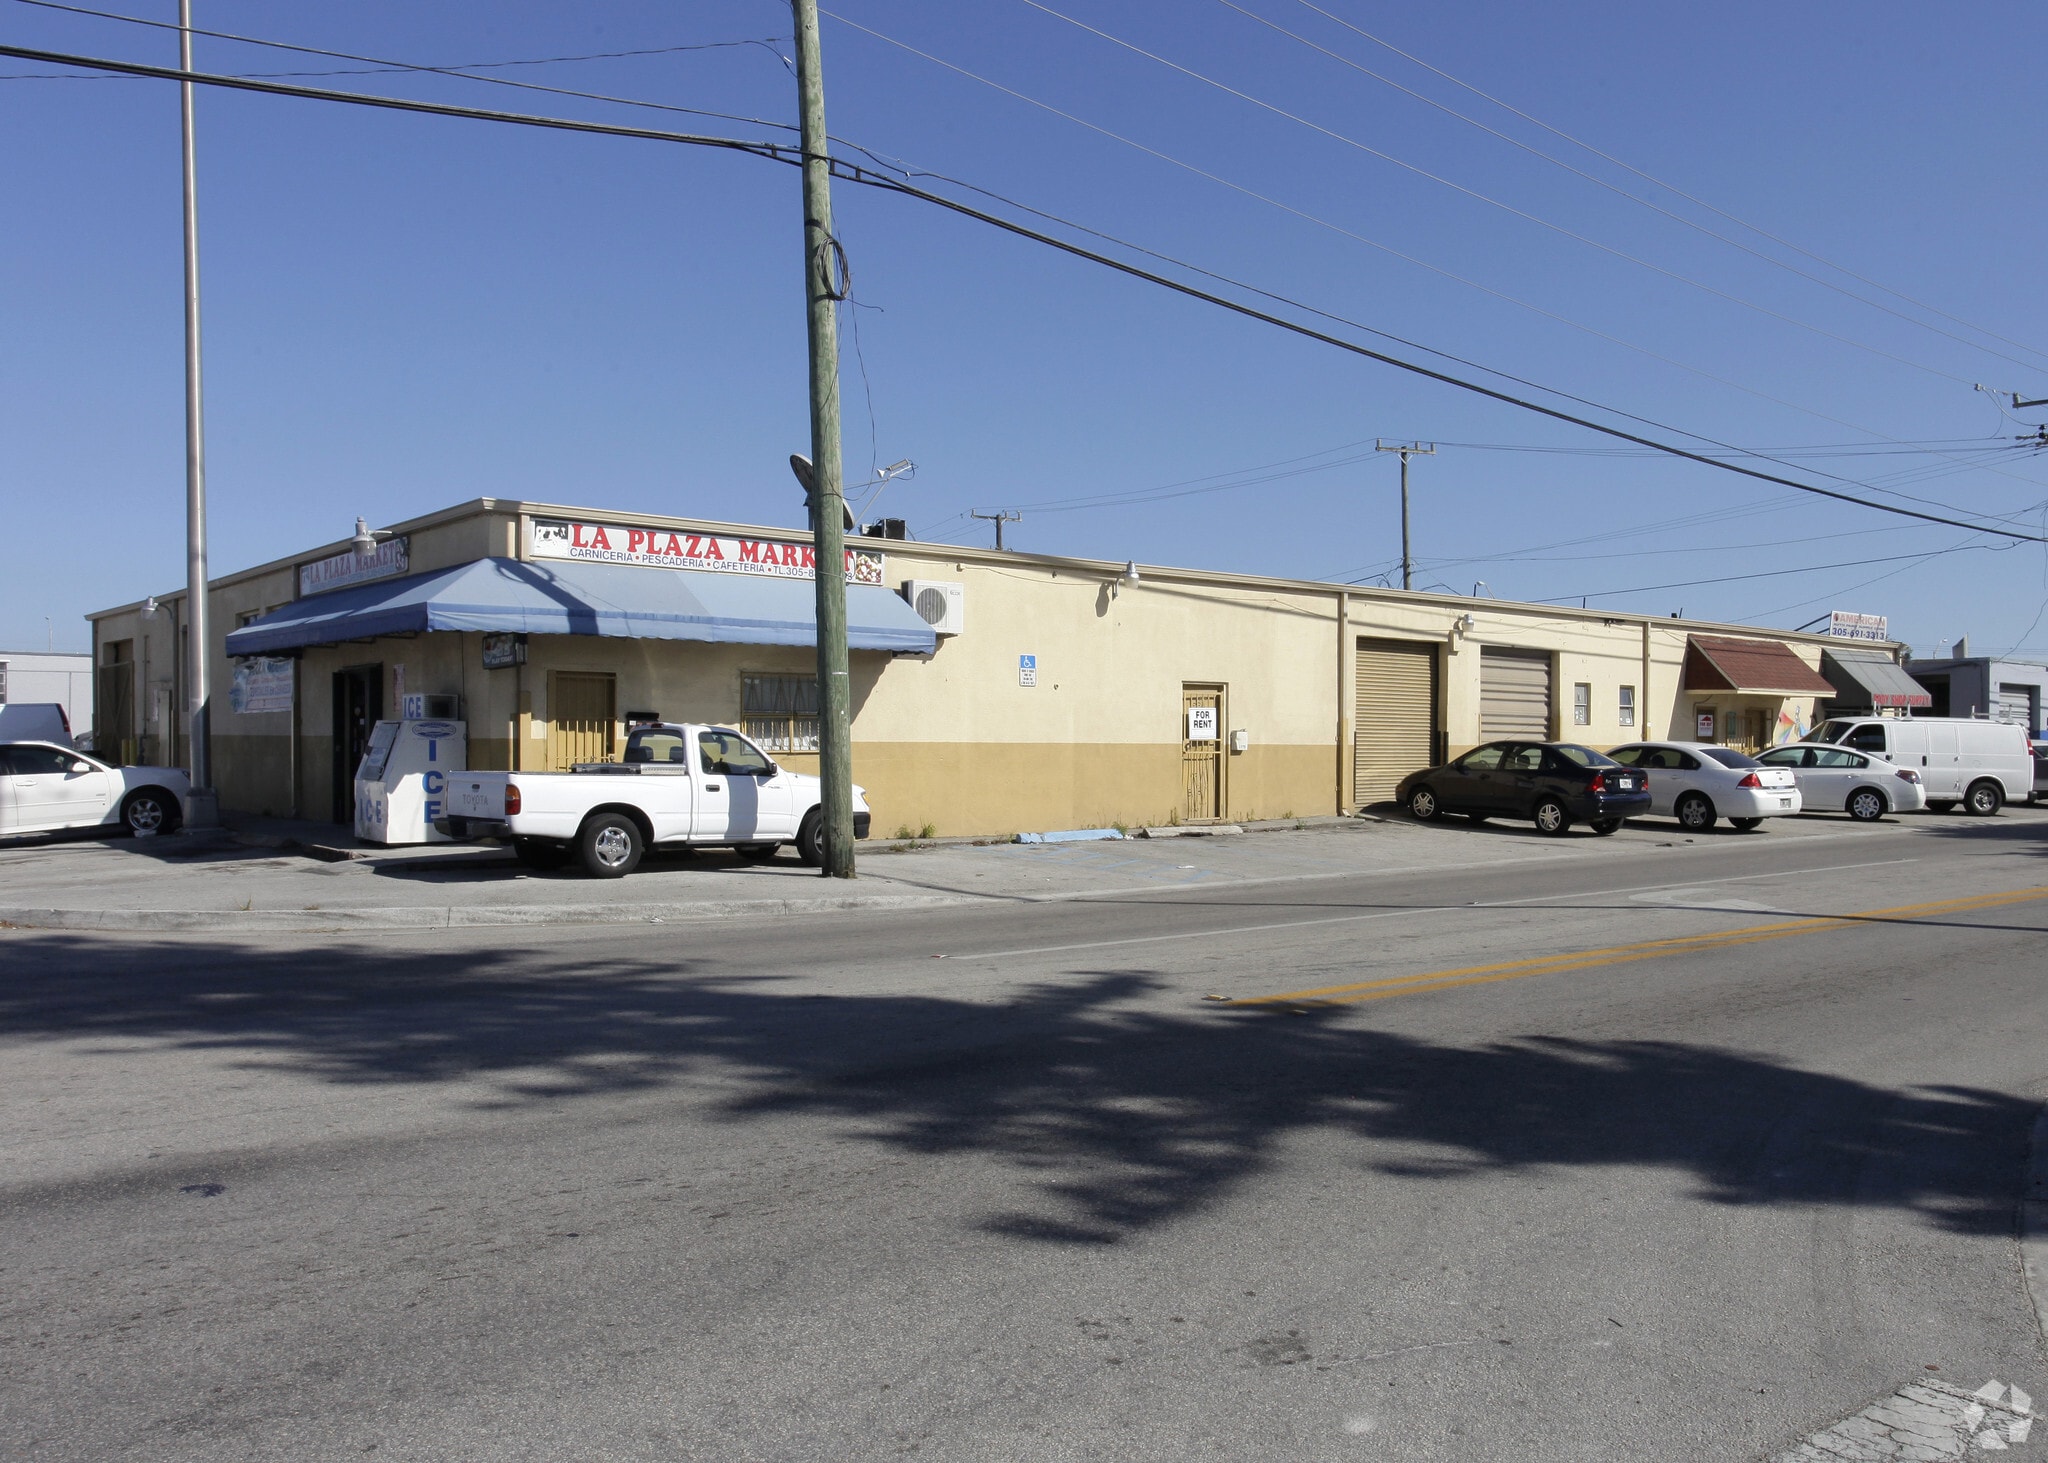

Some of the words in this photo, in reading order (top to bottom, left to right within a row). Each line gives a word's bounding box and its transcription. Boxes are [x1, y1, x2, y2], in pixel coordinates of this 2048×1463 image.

[571, 523, 612, 550] LA
[627, 529, 725, 560] PLAZA
[738, 540, 854, 572] MARKT
[570, 547, 633, 562] CARNICERIA
[642, 554, 704, 568] PESCADERIA
[713, 560, 765, 573] CAFETERIA
[310, 565, 320, 584] LA
[324, 554, 351, 581] PLAZA
[1839, 614, 1886, 627] AMERICAN
[403, 696, 422, 718] ICE
[1195, 711, 1210, 719] FOR
[1193, 720, 1212, 728] RENT
[462, 793, 488, 806] TOYOTA
